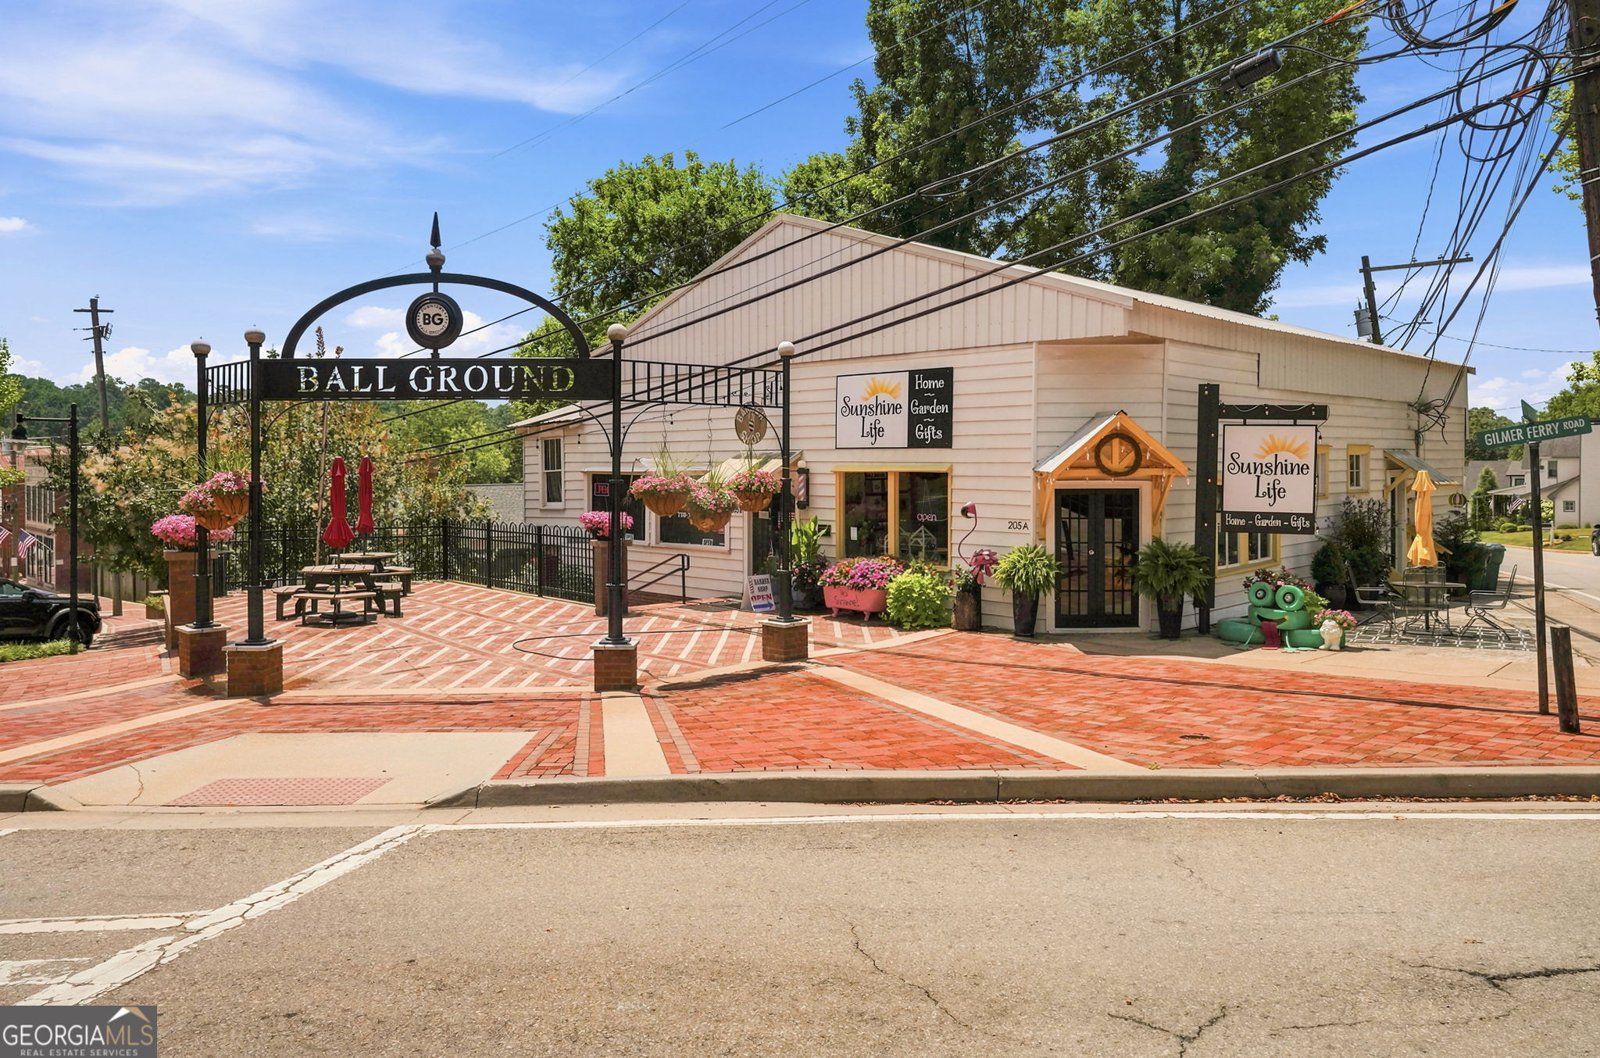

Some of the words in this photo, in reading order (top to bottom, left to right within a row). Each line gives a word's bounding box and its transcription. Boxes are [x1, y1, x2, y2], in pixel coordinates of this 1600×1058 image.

[422, 313, 444, 325] BG
[297, 365, 396, 393] BALL
[408, 365, 575, 393] GROUND
[914, 374, 945, 390] Home
[841, 395, 902, 417] Sunshine
[910, 399, 949, 415] Garden
[861, 416, 885, 445] Life
[915, 424, 943, 444] Gifts
[1484, 429, 1524, 446] GILMER
[1526, 423, 1560, 439] FERRY
[1563, 418, 1585, 430] ROAD
[1227, 452, 1310, 475] Sunshine
[1255, 475, 1287, 507] Life
[916, 513, 937, 522] open
[1007, 520, 1029, 530] 205A
[1225, 513, 1246, 526] Home
[1254, 515, 1282, 527] Garden
[1290, 514, 1310, 531] Gifts
[751, 593, 772, 602] OPEN
